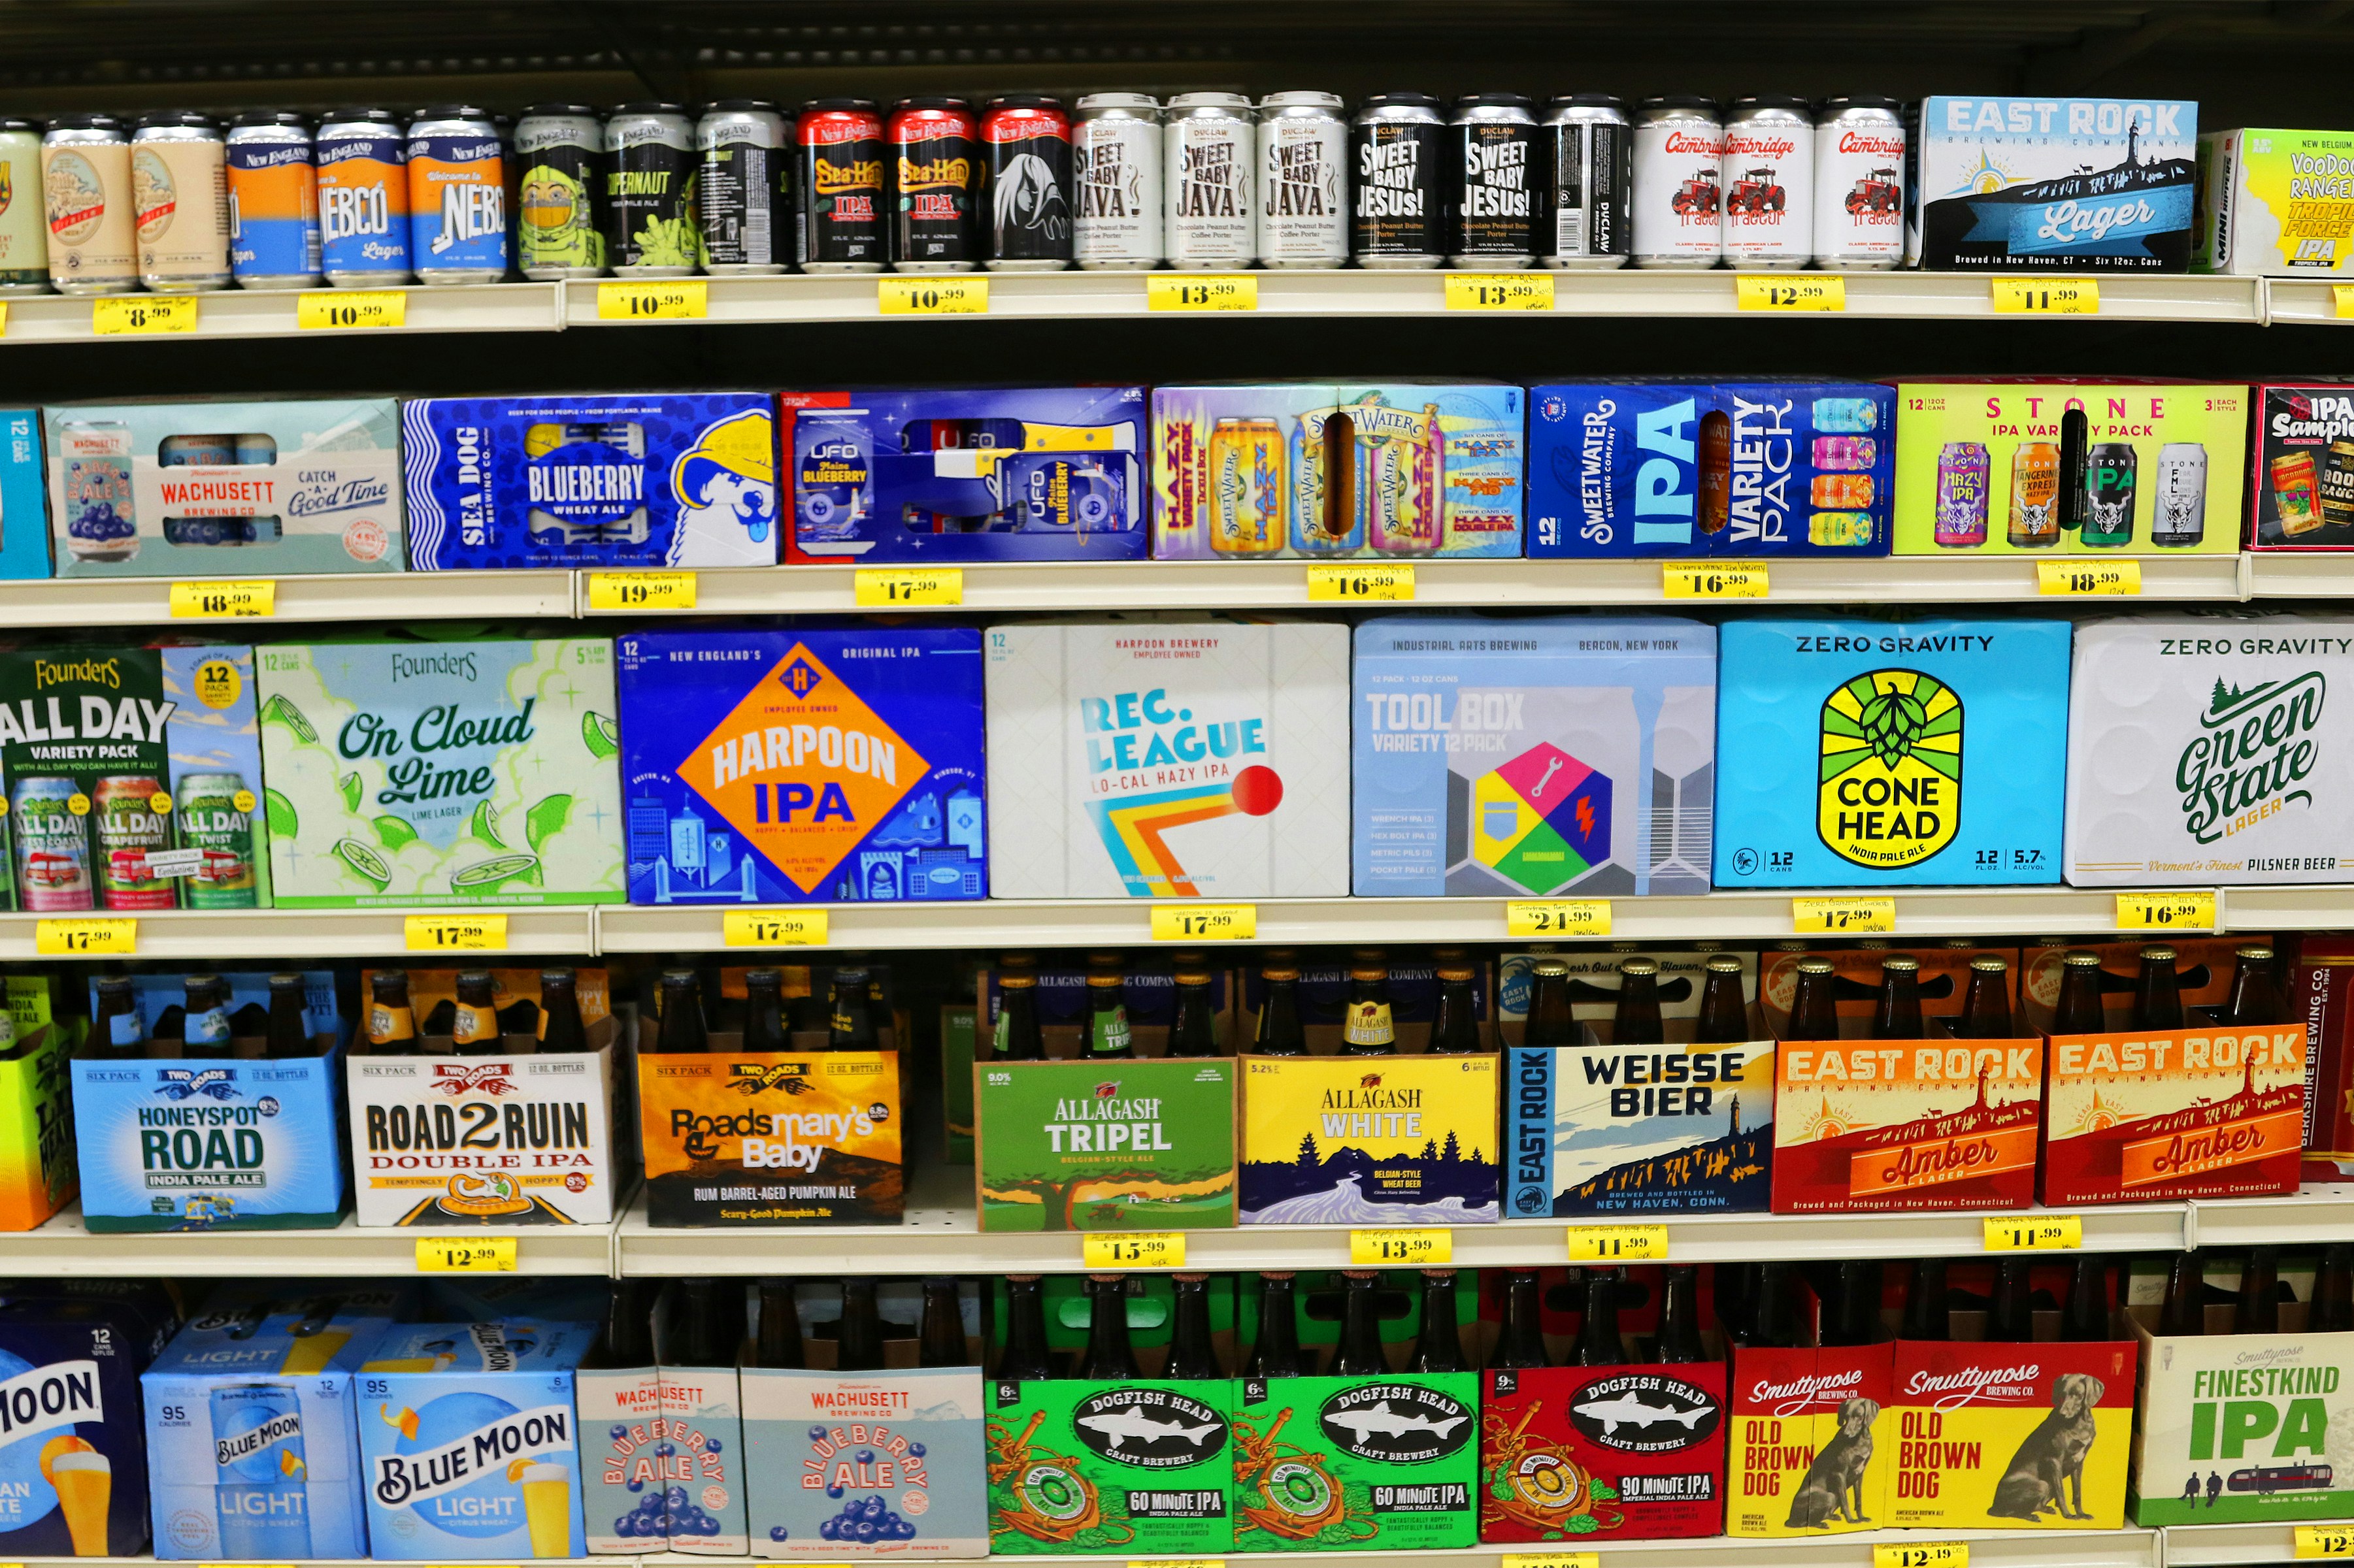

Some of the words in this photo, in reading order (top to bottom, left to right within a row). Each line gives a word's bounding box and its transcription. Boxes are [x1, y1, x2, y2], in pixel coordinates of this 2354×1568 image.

[1948, 102, 2060, 133] EAST
[2069, 102, 2181, 136] ROCK
[1360, 140, 1419, 171] SWEET
[1725, 132, 1795, 155] Cambridge
[1948, 137, 2049, 146] BREWING
[2074, 139, 2180, 147] COMPANY
[1374, 165, 1414, 189] BABY
[915, 195, 953, 214] IPA
[1265, 184, 1321, 218] JAVA
[1357, 192, 1423, 218] JESUS!
[1729, 208, 1789, 225] Tractor
[2038, 199, 2155, 243] Lager
[2218, 212, 2227, 260] MINI
[1955, 255, 1989, 264] Brewed
[2029, 256, 2059, 265] Haven,
[2095, 257, 2110, 265] Six
[2141, 257, 2162, 266] Cans
[1909, 400, 1923, 410] 12
[1987, 398, 2164, 417] STONE
[1993, 426, 2018, 436] IPA
[2027, 425, 2100, 436] VARY
[2109, 425, 2153, 436] PACK
[457, 427, 481, 484] DOG
[810, 445, 857, 458] UFO
[1606, 427, 1616, 468] COMPANY
[299, 472, 337, 483] CATCH
[803, 470, 867, 482] BLUEBERRY
[1581, 400, 1616, 544] SWEETWATER
[1634, 399, 1695, 544] IPA
[1731, 395, 1763, 543] VARIETY
[1761, 399, 1793, 542] PACK
[161, 482, 274, 505] WACHUSETT
[288, 487, 339, 517] Good
[344, 478, 389, 507] Time
[528, 465, 644, 502] BLUEBERRY
[461, 493, 485, 546] SEA
[1116, 640, 1165, 648] HARPOON
[1170, 639, 1219, 647] BREWERY
[1393, 641, 1455, 651] INDUSTRIAL
[1459, 641, 1485, 650] ARTS
[1491, 641, 1537, 651] BREWING
[1580, 641, 1622, 651] BEACON,
[1627, 641, 1648, 650] NEW
[1653, 641, 1678, 650] YORK
[1797, 637, 1870, 652] ZERO
[1880, 636, 1994, 652] GRAVITY
[1081, 689, 1192, 732] REC.
[1367, 694, 1451, 730] TOOL
[1461, 694, 1524, 730] BOX
[339, 713, 402, 759] On
[410, 696, 536, 753] Cloud
[31, 746, 93, 759] VARIETY
[101, 746, 137, 757] PACK
[712, 725, 895, 789] HARPOON
[1086, 718, 1265, 774] LEAGUE
[2176, 687, 2316, 813] Green
[378, 757, 495, 803] Lime
[1091, 777, 1148, 793] LO-CAL
[1158, 770, 1195, 785] HAZY
[1205, 764, 1229, 778] IPA
[1838, 778, 1940, 806] CONE
[2186, 739, 2319, 835] State
[754, 782, 855, 823] IPA
[1838, 811, 1940, 840] HEAD
[2226, 798, 2281, 837] LAGER
[1849, 843, 1877, 861] INDIA
[1880, 849, 1906, 861] PALE
[1907, 843, 1926, 857] ALE
[2148, 860, 2202, 870] Vermont's
[2206, 860, 2243, 870] Finest
[2248, 858, 2299, 870] PILSNER
[2304, 858, 2335, 869] BEER
[2313, 968, 2324, 994] CO.
[2306, 997, 2321, 1064] BREWING
[1582, 1053, 1744, 1085] WEISSE
[1788, 1050, 1902, 1081] EAST
[1915, 1048, 2033, 1079] ROCK
[1321, 1088, 1421, 1109] ALLAGASH
[1521, 1053, 1548, 1119] ROCK
[1054, 1098, 1159, 1122] ALLAGASH
[1611, 1086, 1712, 1117] BIER
[139, 1107, 259, 1126] HONEYSPOT
[367, 1105, 455, 1151] ROAD
[460, 1103, 500, 1148] 2
[505, 1103, 589, 1150] RUIN
[672, 1105, 874, 1143] Roadsmary's
[1321, 1112, 1421, 1137] WHITE
[141, 1129, 264, 1169] ROAD
[1044, 1123, 1172, 1152] TRIPEL
[371, 1156, 520, 1169] DOUBLE
[533, 1154, 593, 1167] IPA
[743, 1139, 821, 1173] Baby
[1519, 1124, 1546, 1183] EAST
[1883, 1139, 1998, 1186] Amber
[1919, 1171, 1963, 1185] LAGER
[695, 1188, 718, 1201] RUM
[721, 1188, 786, 1201] BARREL-AGED
[789, 1187, 836, 1200] PUMPKIN
[839, 1187, 855, 1200] ALE
[1597, 1200, 1627, 1209] NEW
[1633, 1198, 1683, 1207] HAVEN,
[1690, 1197, 1729, 1206] CONN.
[367, 1380, 387, 1392] 95
[1904, 1364, 2039, 1413] Smuttynose
[1987, 1386, 2019, 1396] BREWING
[2023, 1386, 2034, 1396] CO.
[2194, 1367, 2340, 1397] FINESTKIND
[812, 1392, 908, 1409] WACHUSETT
[1091, 1392, 1165, 1413] DOGFISH
[1170, 1397, 1213, 1422] HEAD
[1901, 1413, 1941, 1439] OLD
[2189, 1398, 2327, 1460] IPA
[378, 1446, 467, 1504] BLUE
[474, 1414, 567, 1468] MOON
[1106, 1449, 1140, 1463] CRAFT
[1143, 1454, 1193, 1465] BREWERY
[1900, 1443, 1981, 1469] BROWN
[834, 1462, 895, 1488] ALE
[1622, 1478, 1639, 1495] 90
[1646, 1478, 1684, 1494] MINUTE
[1687, 1475, 1710, 1493] IPA
[1897, 1472, 1940, 1498] DOG
[437, 1497, 516, 1516] LIGHT
[1130, 1492, 1144, 1511] 60
[1152, 1494, 1193, 1510] MINUTE
[1197, 1492, 1220, 1510] IPA
